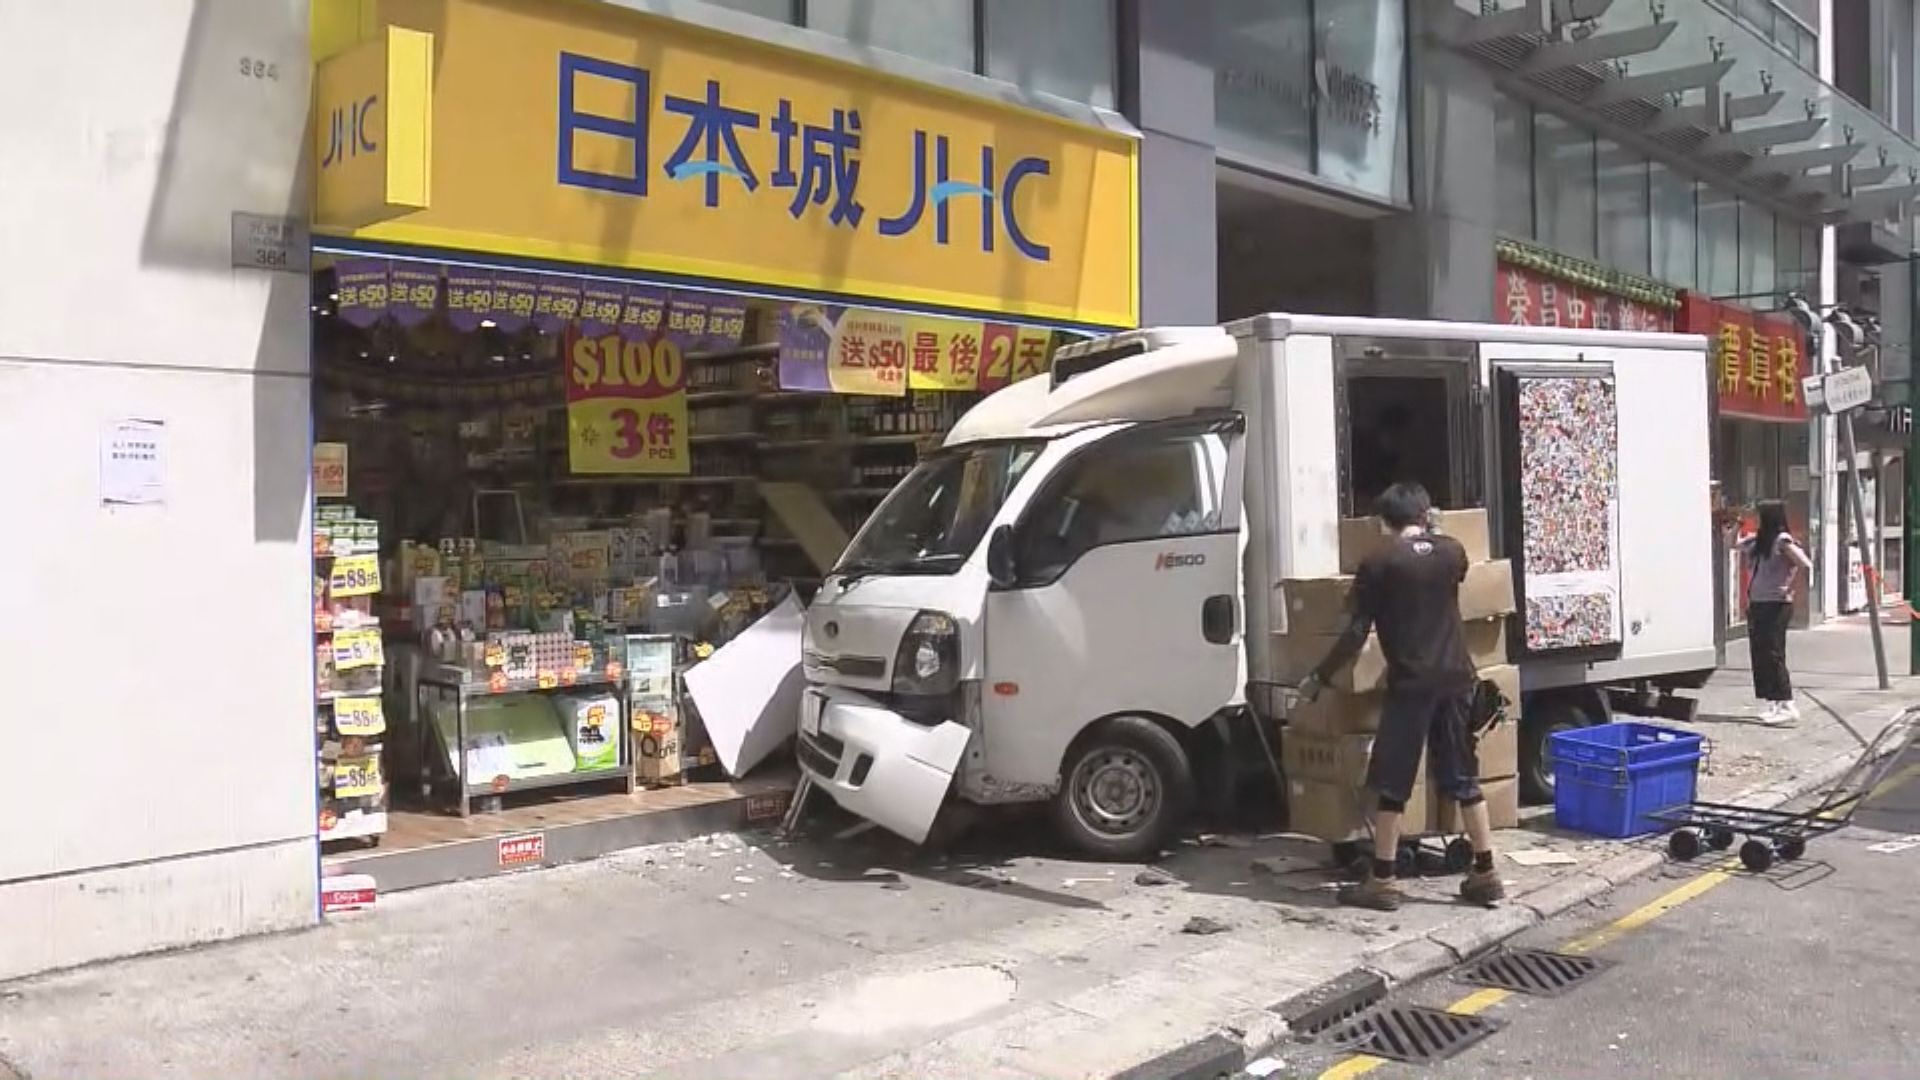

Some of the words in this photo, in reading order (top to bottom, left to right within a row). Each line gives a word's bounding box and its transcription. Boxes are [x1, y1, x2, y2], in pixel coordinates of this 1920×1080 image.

[240, 57, 279, 82] 364
[322, 95, 378, 168] JHC
[558, 51, 865, 228] 日本城
[878, 130, 1050, 262] JHC
[256, 249, 287, 266] 364
[573, 335, 682, 391] $100
[841, 335, 906, 369] 送$50
[912, 331, 1046, 378] 最後2天
[609, 407, 676, 459] 3件
